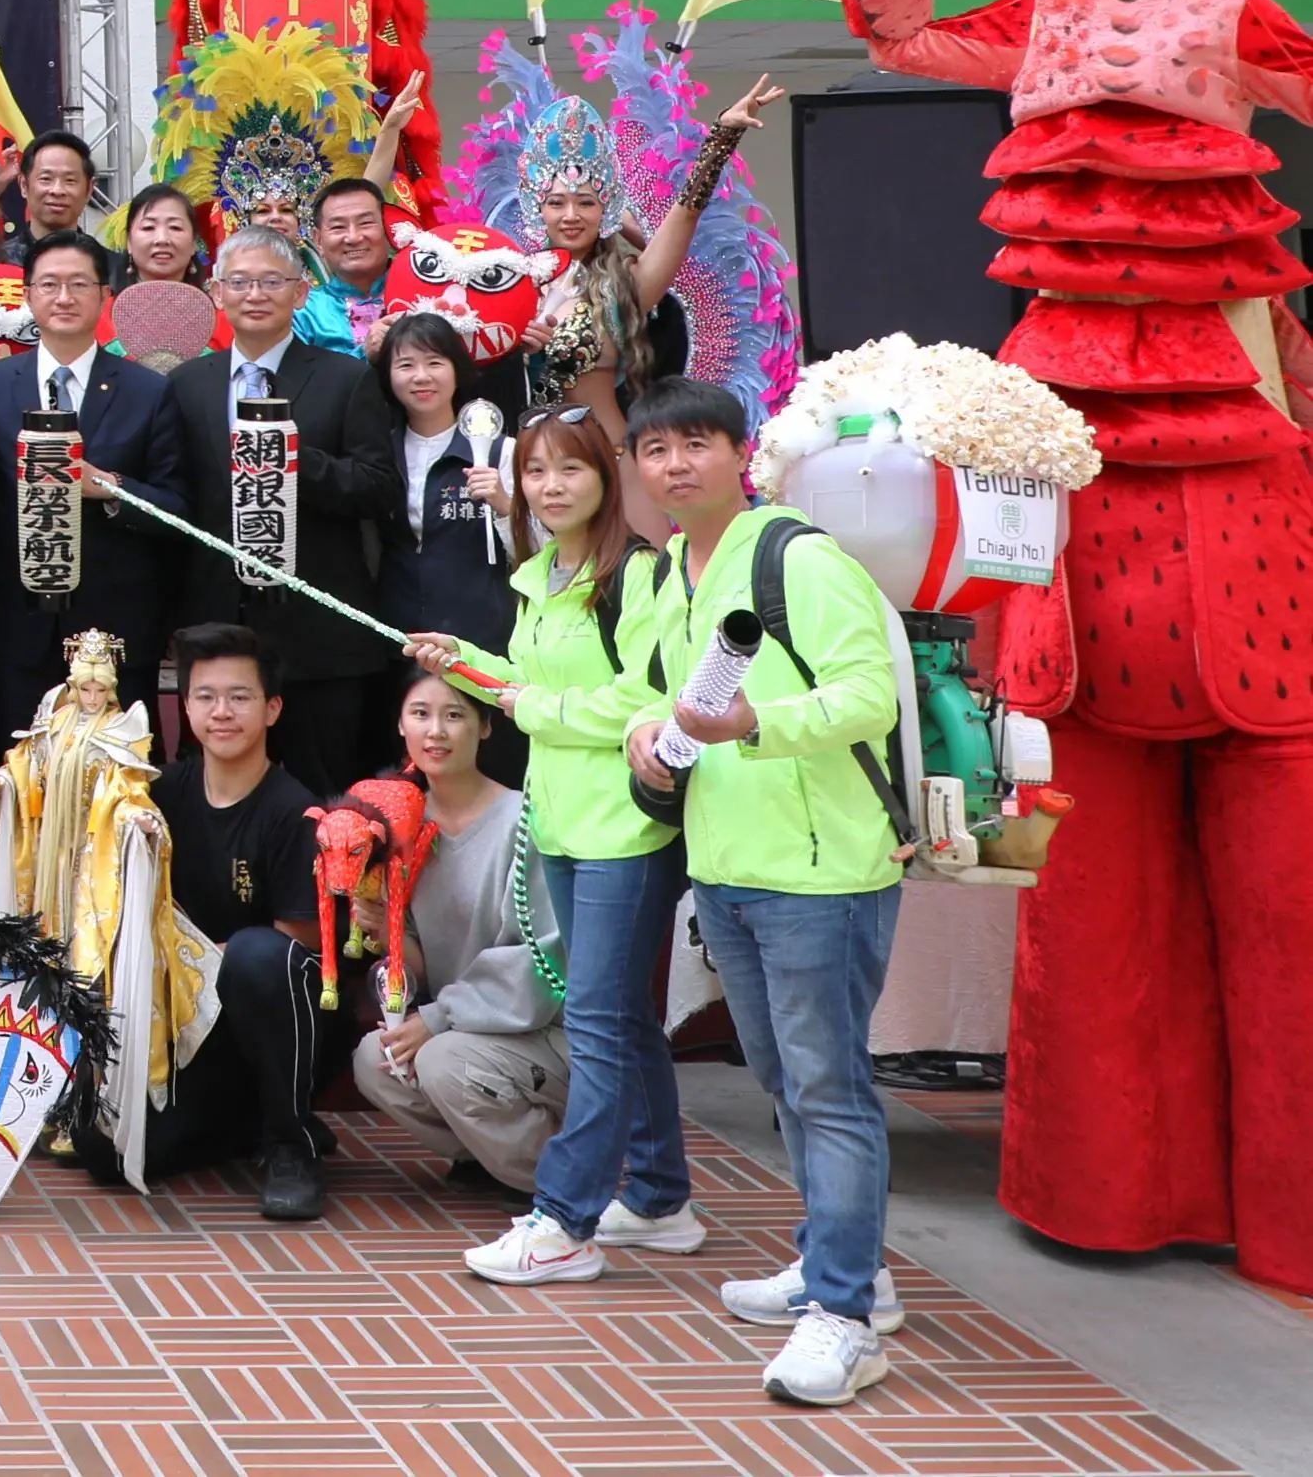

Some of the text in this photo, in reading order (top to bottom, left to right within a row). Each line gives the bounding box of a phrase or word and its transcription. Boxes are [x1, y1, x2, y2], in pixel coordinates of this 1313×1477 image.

[22, 440, 75, 590] 長榮航空
[978, 538, 1046, 562] Chiayi No.1
